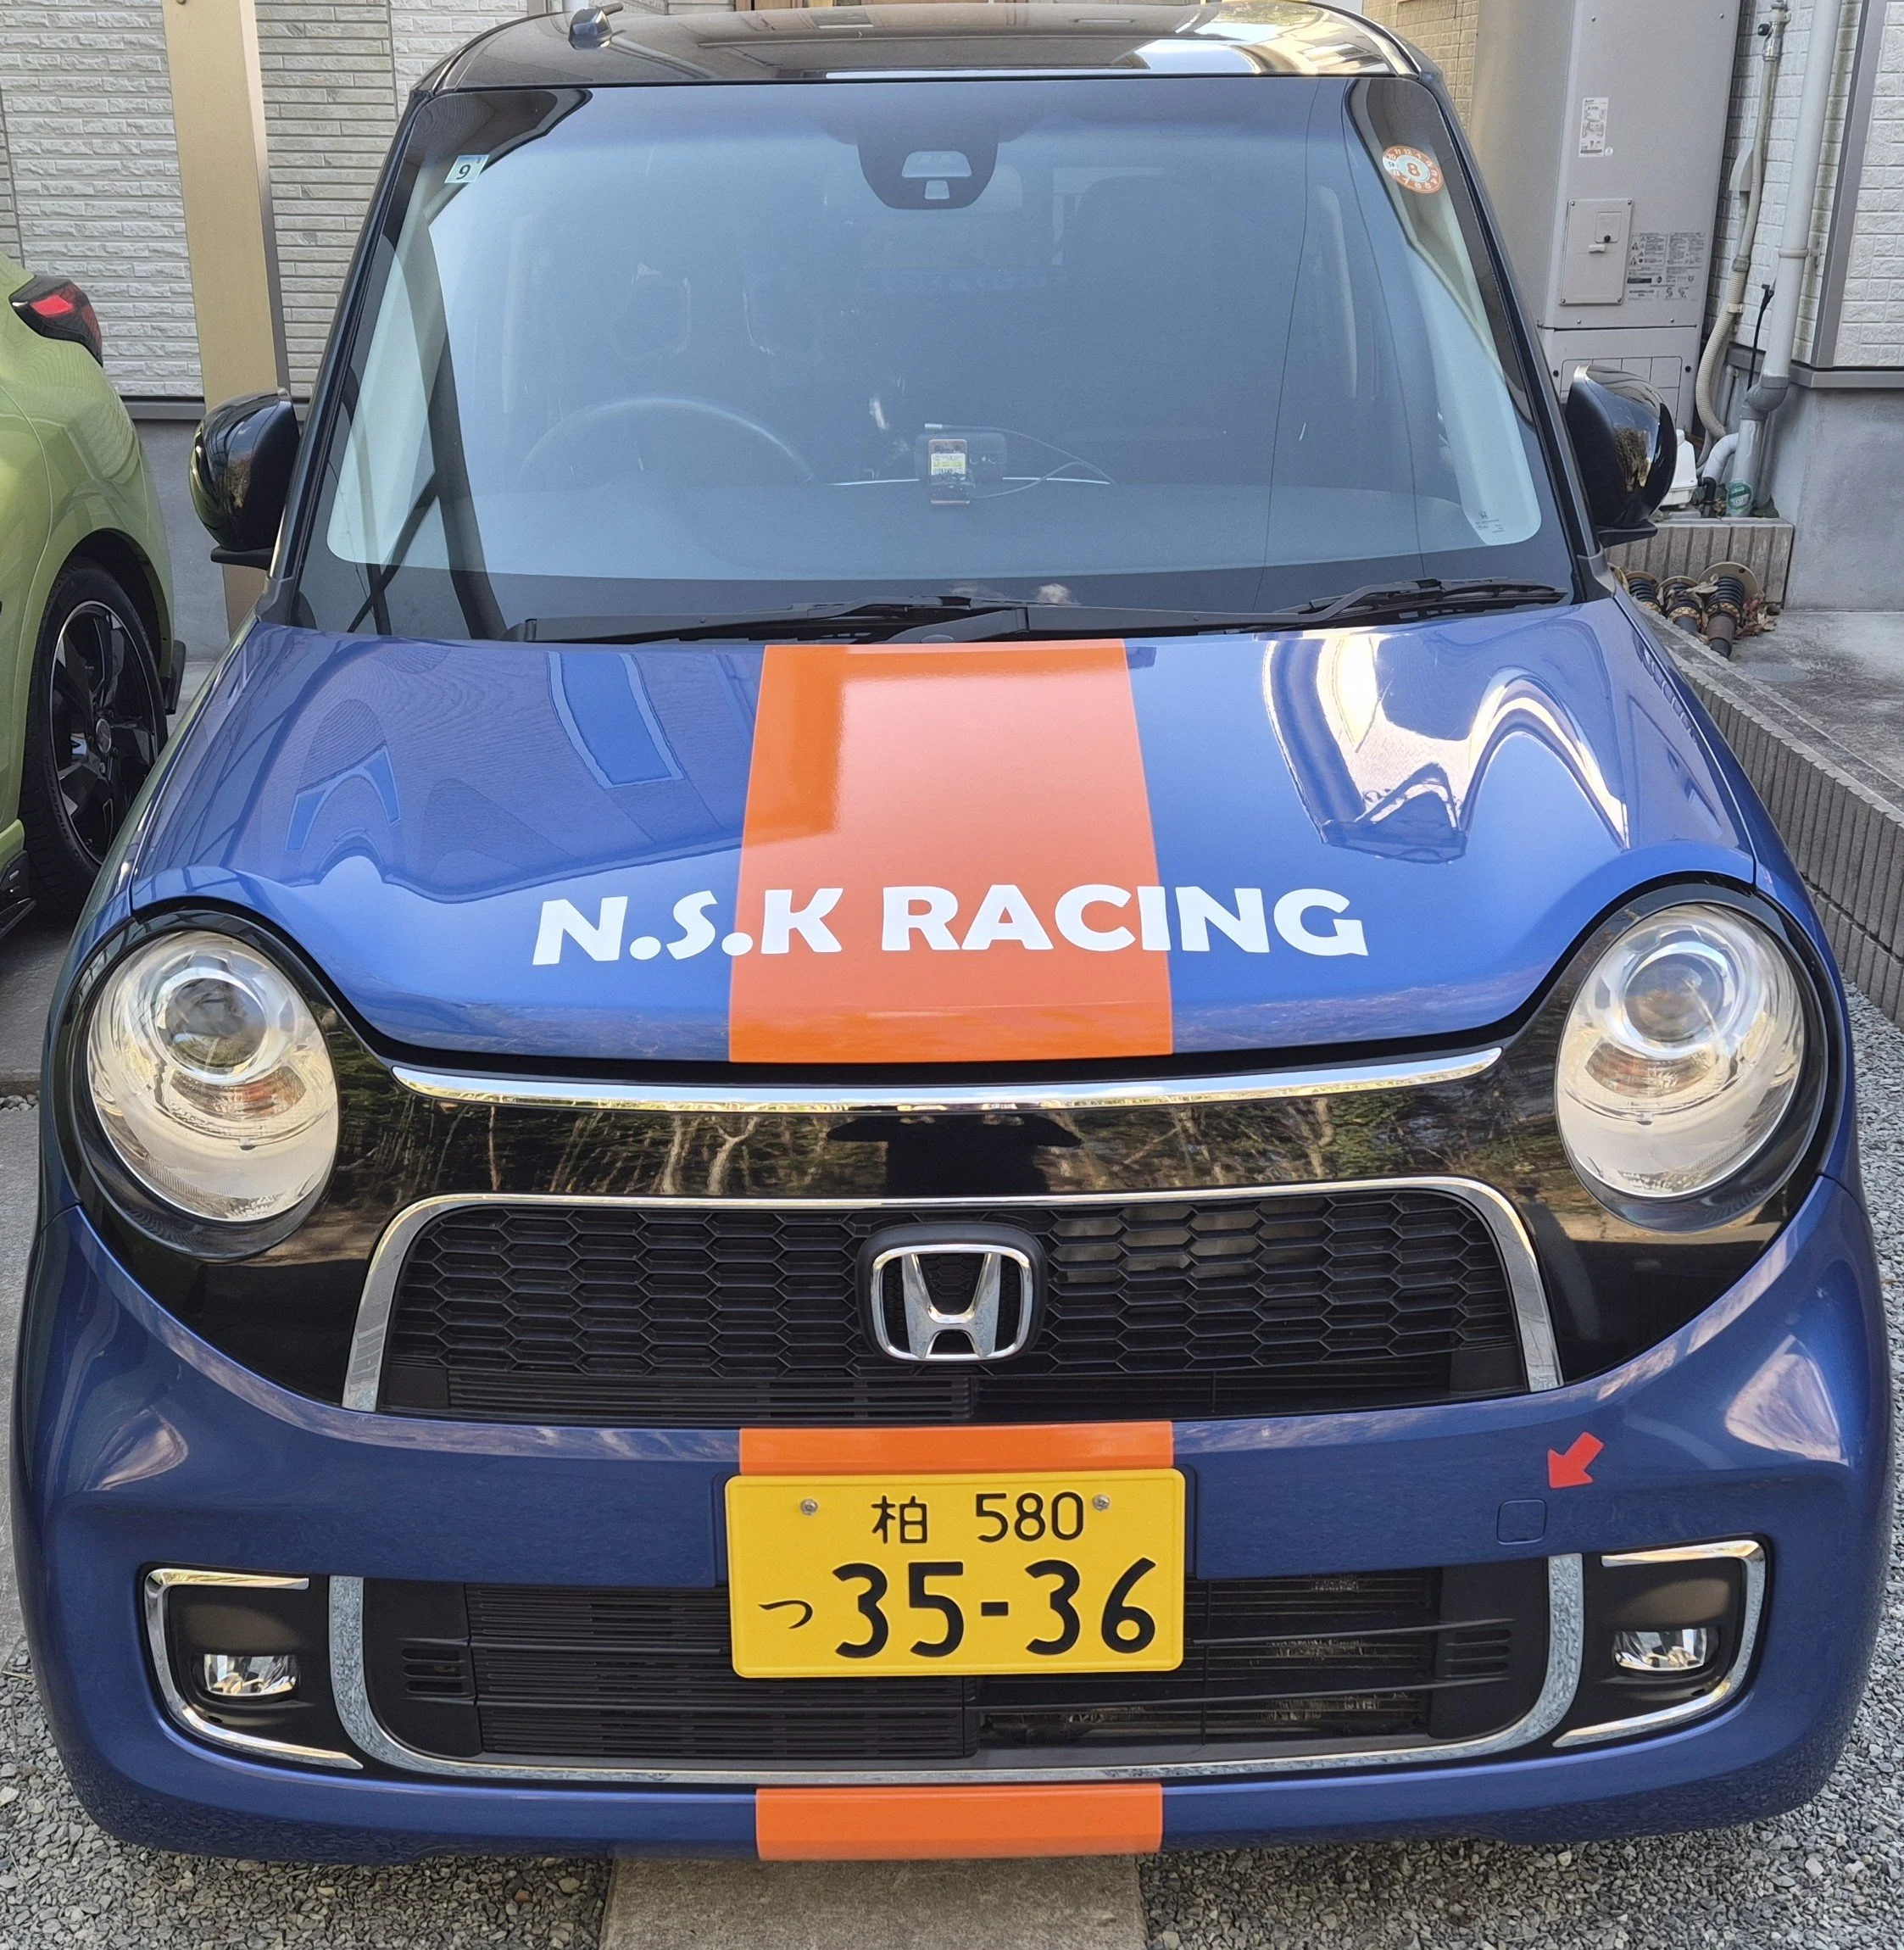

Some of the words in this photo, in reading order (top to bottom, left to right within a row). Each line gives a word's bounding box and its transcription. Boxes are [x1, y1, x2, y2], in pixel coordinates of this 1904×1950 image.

[456, 164, 471, 181] 9
[1406, 162, 1421, 177] 8
[532, 888, 843, 966] N.S.K
[882, 883, 1368, 956] RACING
[871, 1496, 928, 1544] 柏
[975, 1491, 1084, 1543] 580
[758, 1599, 815, 1630] つ
[832, 1557, 1157, 1659] 35-36
